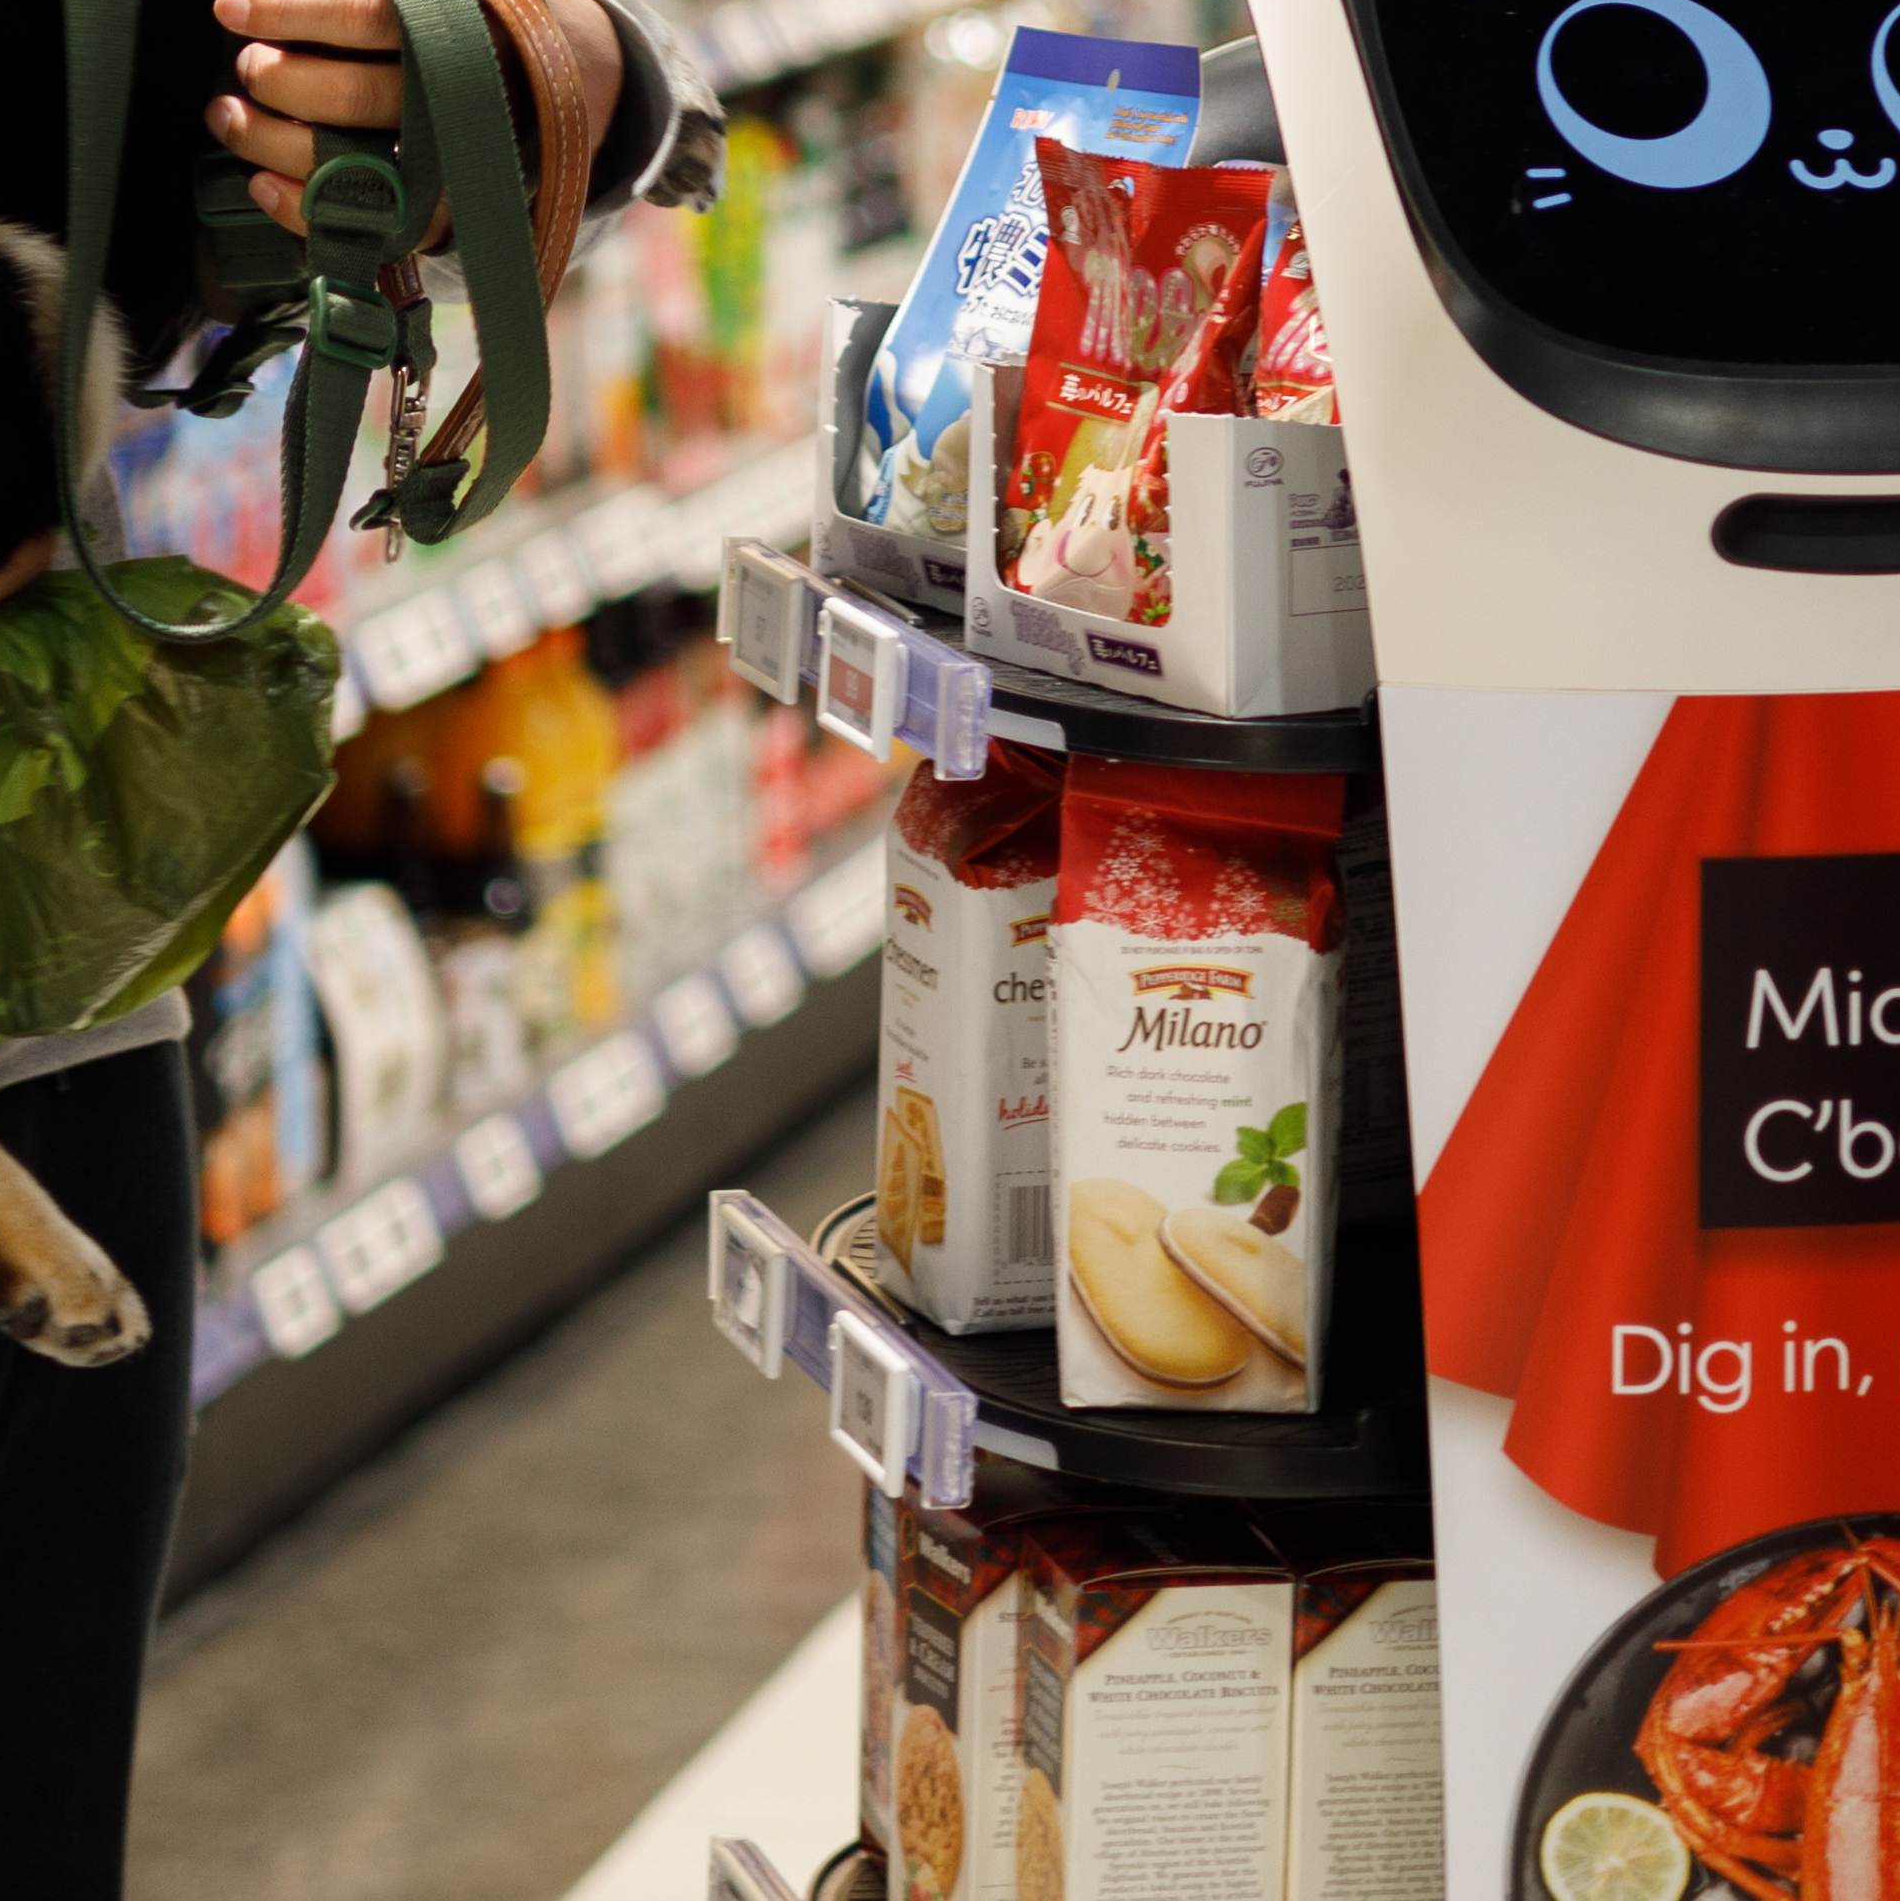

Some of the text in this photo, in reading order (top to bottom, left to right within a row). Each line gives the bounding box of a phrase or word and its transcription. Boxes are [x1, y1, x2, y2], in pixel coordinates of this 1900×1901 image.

[1115, 1005, 1264, 1053] Milano
[1106, 1064, 1231, 1084] Rich dark chocolate
[1150, 1113, 1206, 1129] between
[1116, 1135, 1167, 1151] delicate
[1611, 1320, 1753, 1414] Dig
[1783, 1320, 1875, 1397] in,
[1146, 1625, 1273, 1650] Walkers
